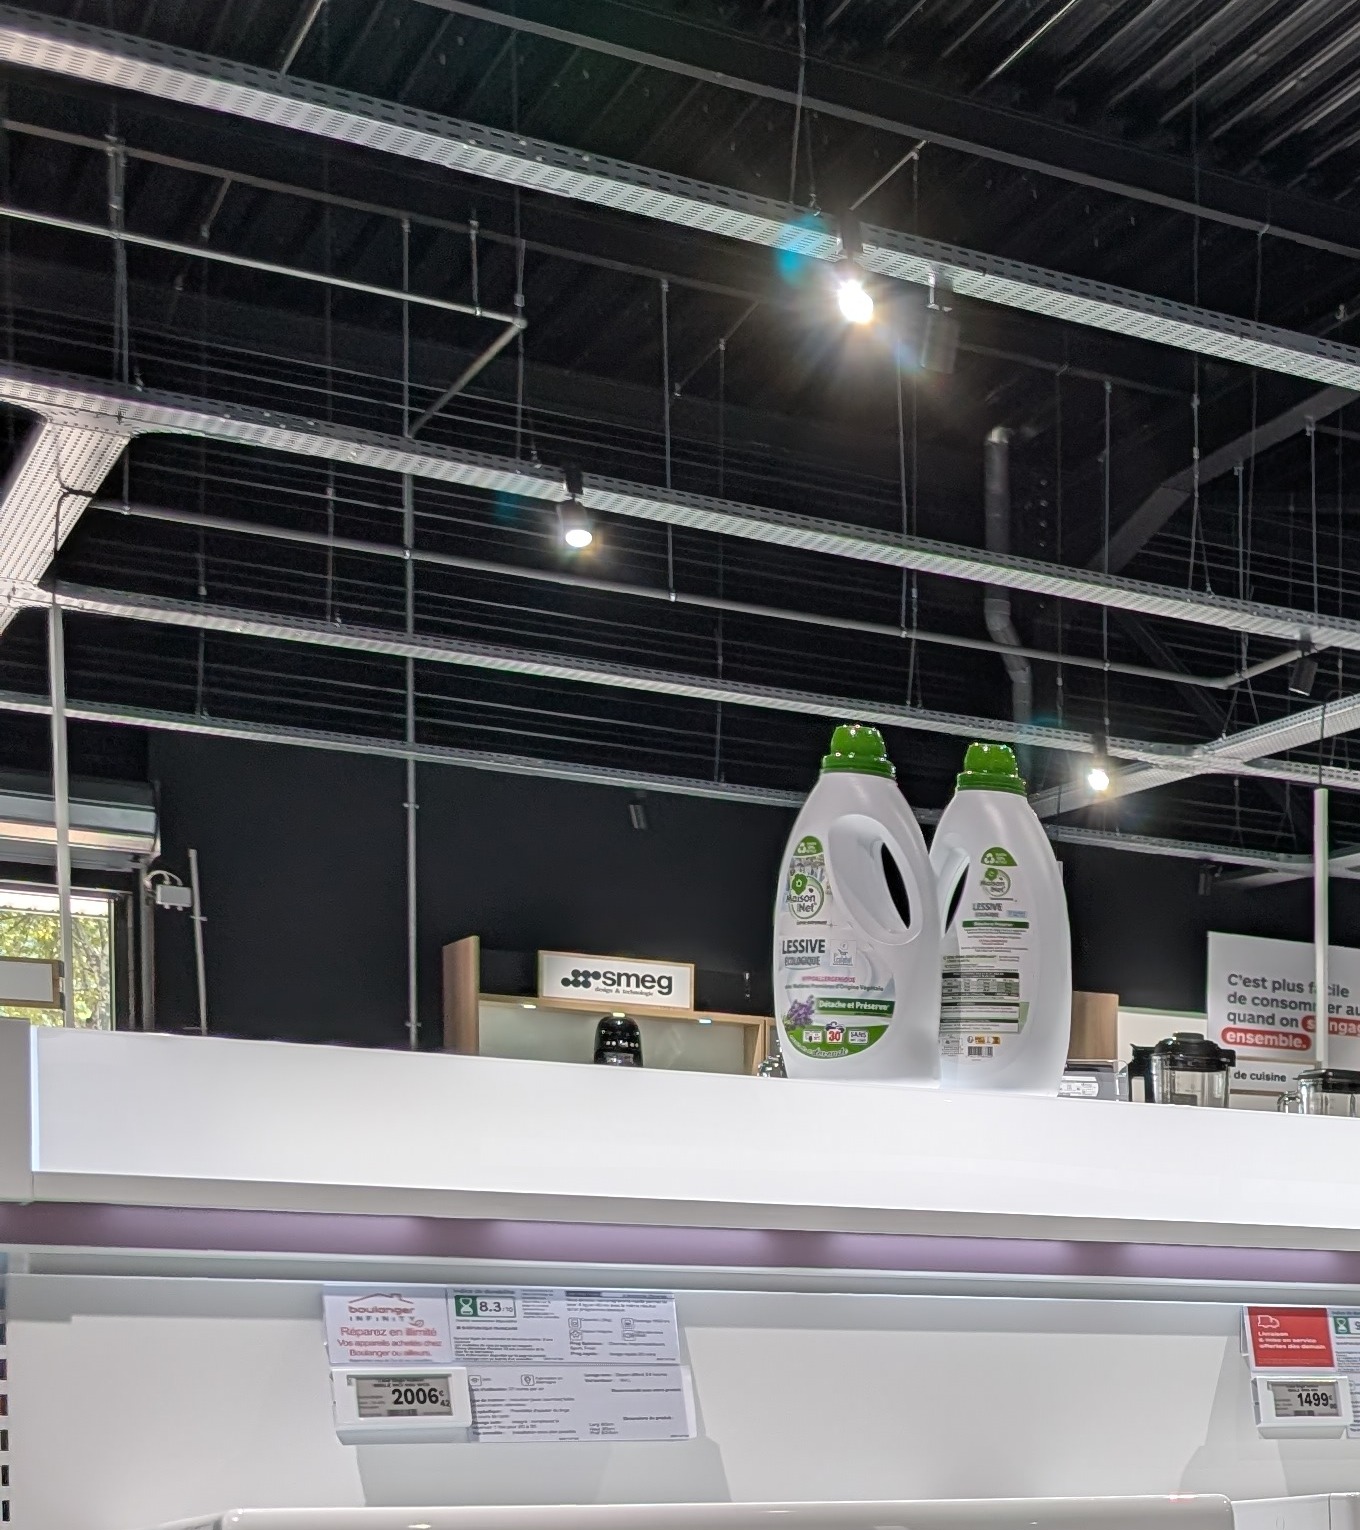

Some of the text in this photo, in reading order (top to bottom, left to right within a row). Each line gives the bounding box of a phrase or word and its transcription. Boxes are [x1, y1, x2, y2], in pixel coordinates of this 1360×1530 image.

[782, 939, 826, 954] LESSIVE
[602, 970, 673, 995] smeg
[1228, 973, 1267, 990] C'est
[1272, 979, 1304, 993] plus
[819, 1000, 846, 1009] Détache
[1227, 992, 1247, 1005] de
[1251, 996, 1341, 1015] consomer
[1227, 1011, 1276, 1028] quand
[1280, 1015, 1299, 1028] on
[828, 1031, 841, 1041] 30
[1226, 1030, 1307, 1049] ensemble.
[1234, 1070, 1287, 1083] de cuisine
[348, 1305, 414, 1314] boulanger
[340, 1327, 387, 1337] Réparez
[337, 1339, 353, 1347] Vos
[350, 1349, 390, 1357] Boulanger
